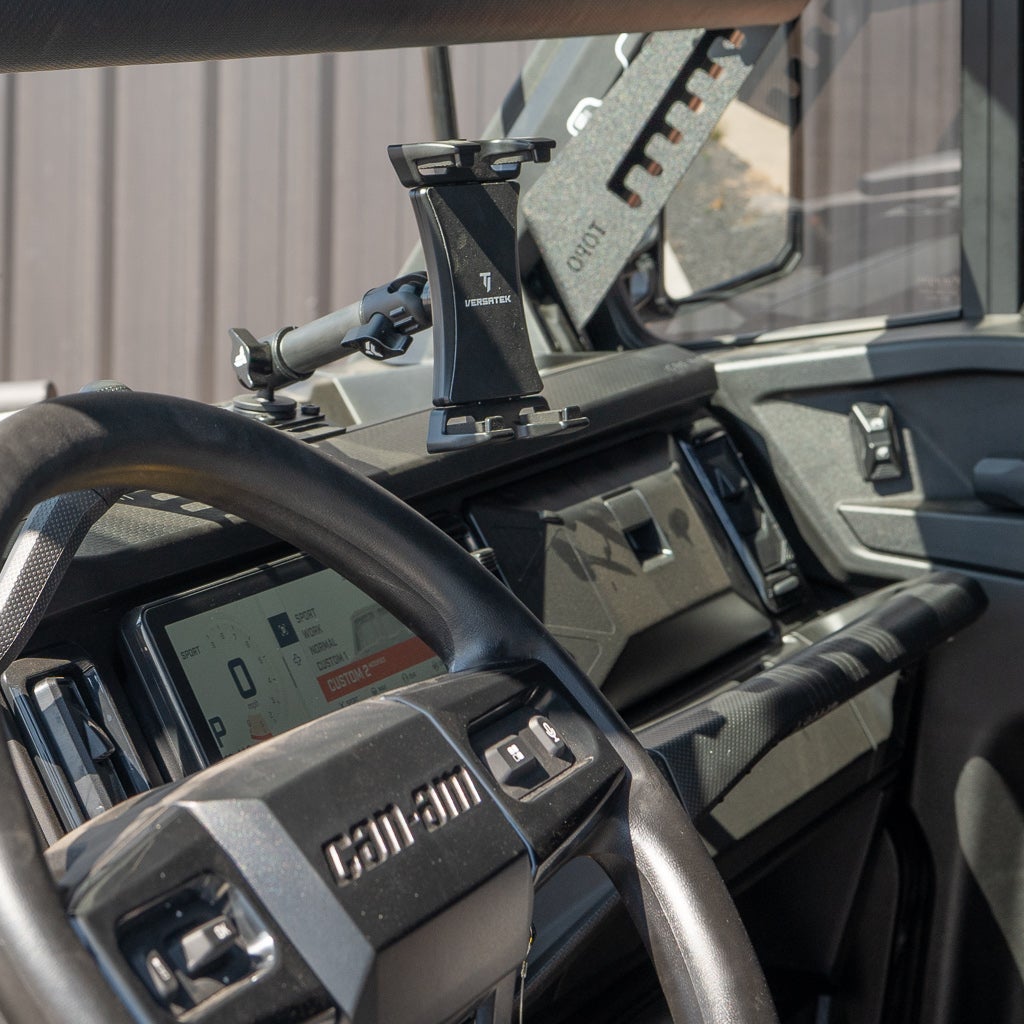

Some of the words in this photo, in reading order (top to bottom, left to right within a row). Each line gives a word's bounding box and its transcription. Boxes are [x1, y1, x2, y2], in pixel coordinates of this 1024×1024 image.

[465, 295, 512, 308] VERSATEK
[294, 608, 317, 624] SPORT
[302, 624, 324, 639] WORK
[180, 646, 202, 660] SPORT
[310, 638, 338, 656] NORMAL
[316, 653, 344, 671] CUSTOM
[228, 657, 257, 700] 0
[327, 669, 363, 692] CUSTOM
[362, 665, 373, 678] 2
[208, 716, 226, 748] P
